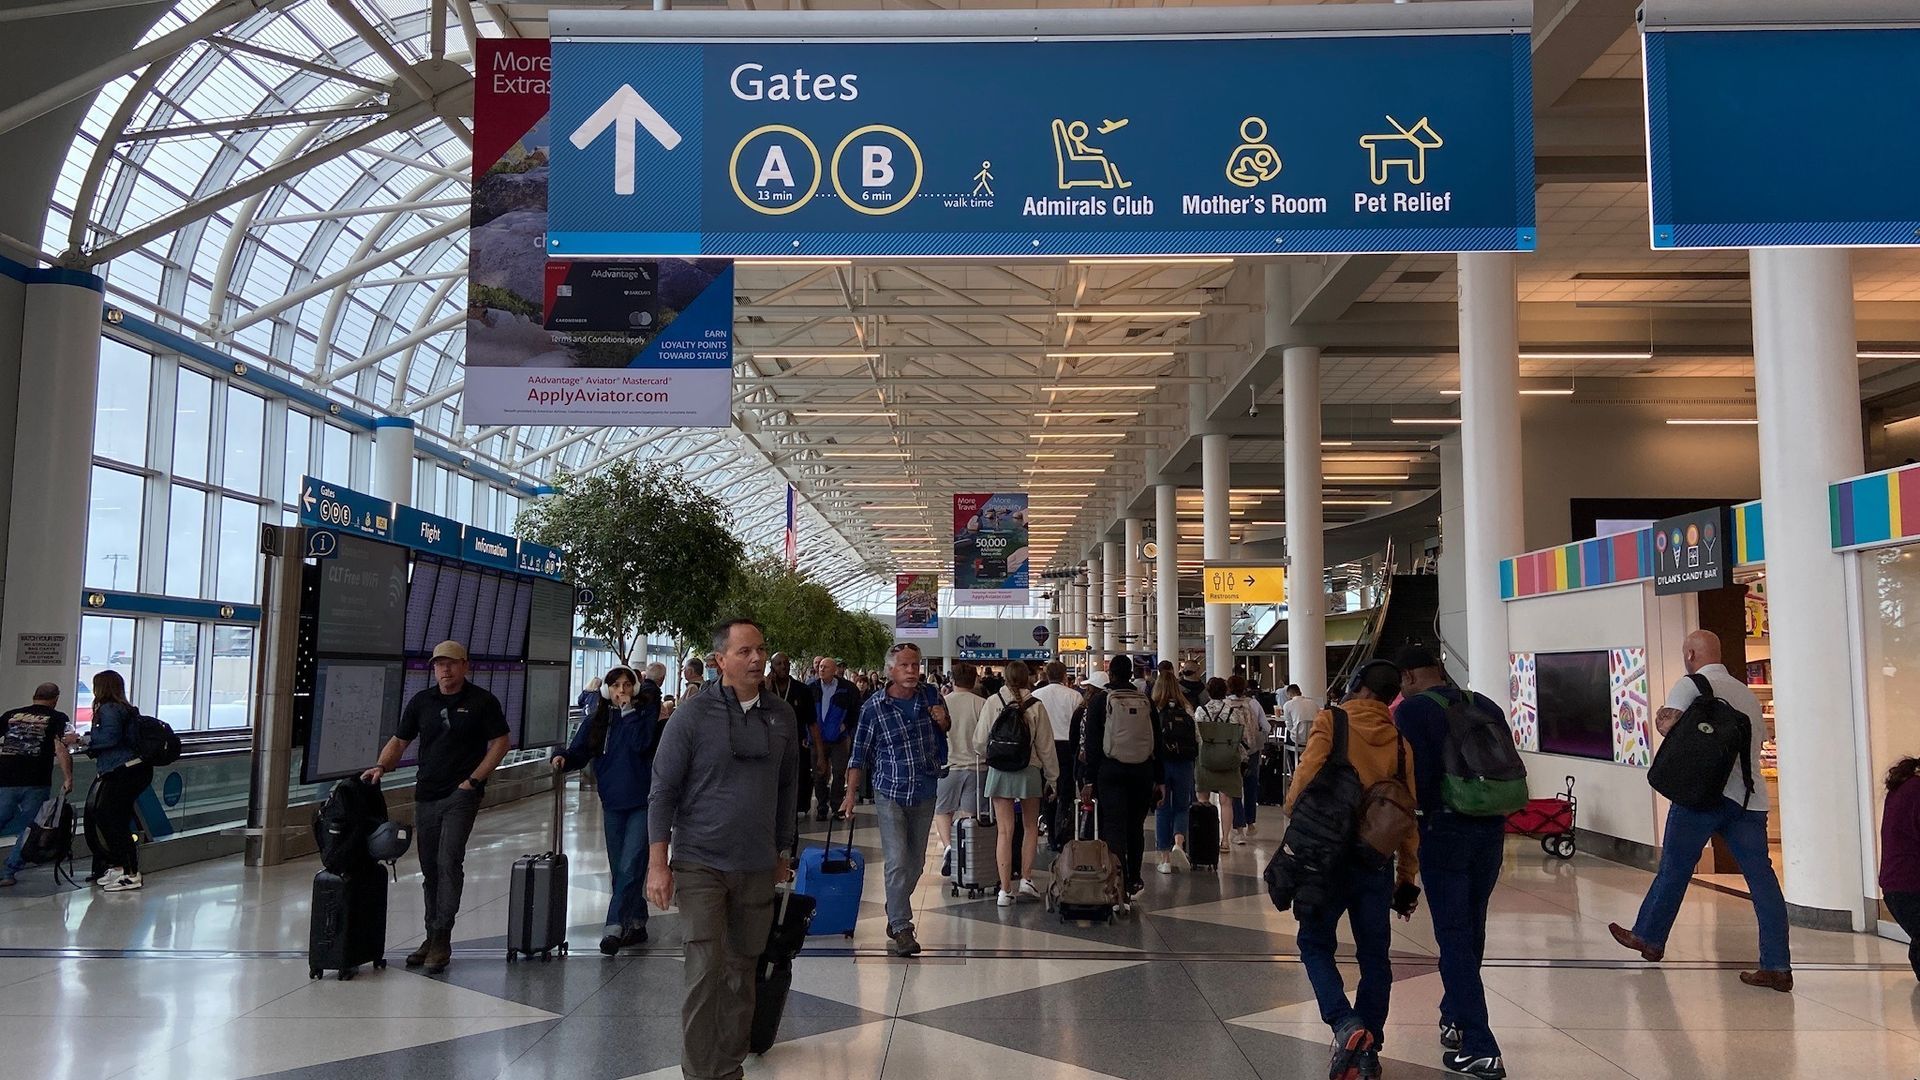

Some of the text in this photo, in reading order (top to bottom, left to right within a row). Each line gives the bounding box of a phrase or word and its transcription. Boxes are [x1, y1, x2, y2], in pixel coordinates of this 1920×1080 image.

[493, 51, 552, 72] More
[730, 62, 858, 101] Gates
[755, 145, 795, 187] A
[862, 145, 894, 187] B
[758, 190, 793, 201] 13 min
[862, 190, 892, 201] 6 min
[943, 197, 994, 208] walk time
[1354, 191, 1451, 213] Pet Relief
[1023, 195, 1154, 216] Admirals Club
[1182, 194, 1327, 215] Mother's Room
[590, 269, 639, 280] AAdvantage
[550, 334, 646, 345] Terms and Conditions apply
[704, 330, 727, 338] EARN
[661, 341, 727, 349] LOYALTY POINTS
[659, 352, 696, 360] TOWARD
[527, 388, 669, 405] ApplyAviator.com
[320, 485, 336, 498] Gates
[322, 503, 328, 513] C
[333, 508, 339, 517] D
[957, 503, 977, 511] Travel
[420, 521, 441, 544] Flight
[475, 537, 508, 558] Information
[976, 538, 1007, 549] 50,000
[1657, 574, 1681, 585] DYLAN'S
[1681, 571, 1703, 581] CANDY
